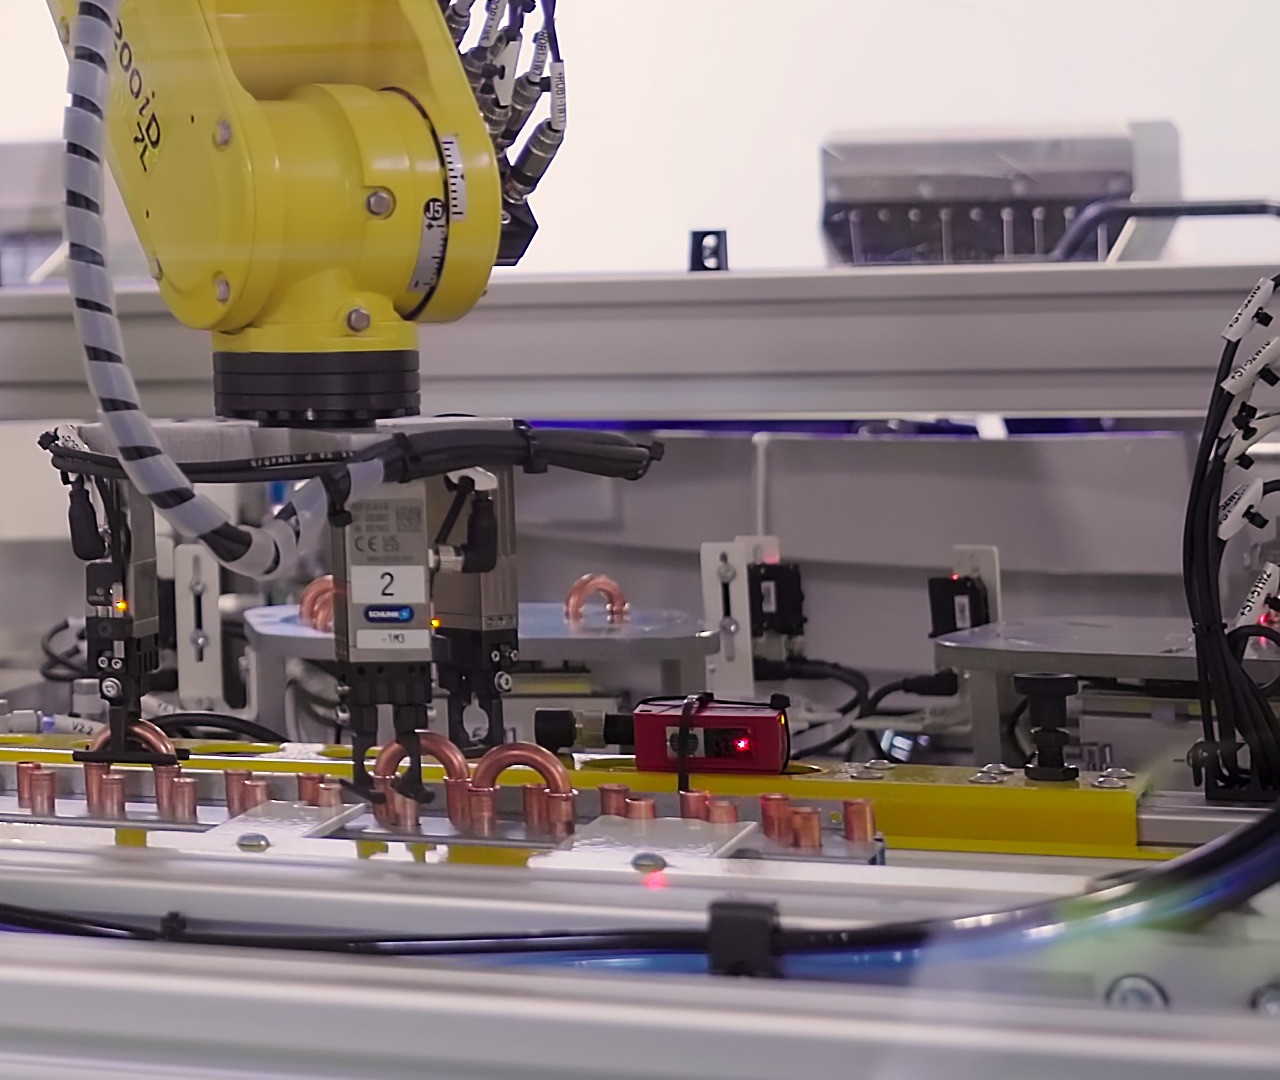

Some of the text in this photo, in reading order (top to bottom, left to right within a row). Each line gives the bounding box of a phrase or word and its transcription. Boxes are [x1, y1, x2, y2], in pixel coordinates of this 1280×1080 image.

[133, 121, 150, 172] 7L
[425, 201, 443, 218] J5
[379, 571, 395, 597] 2
